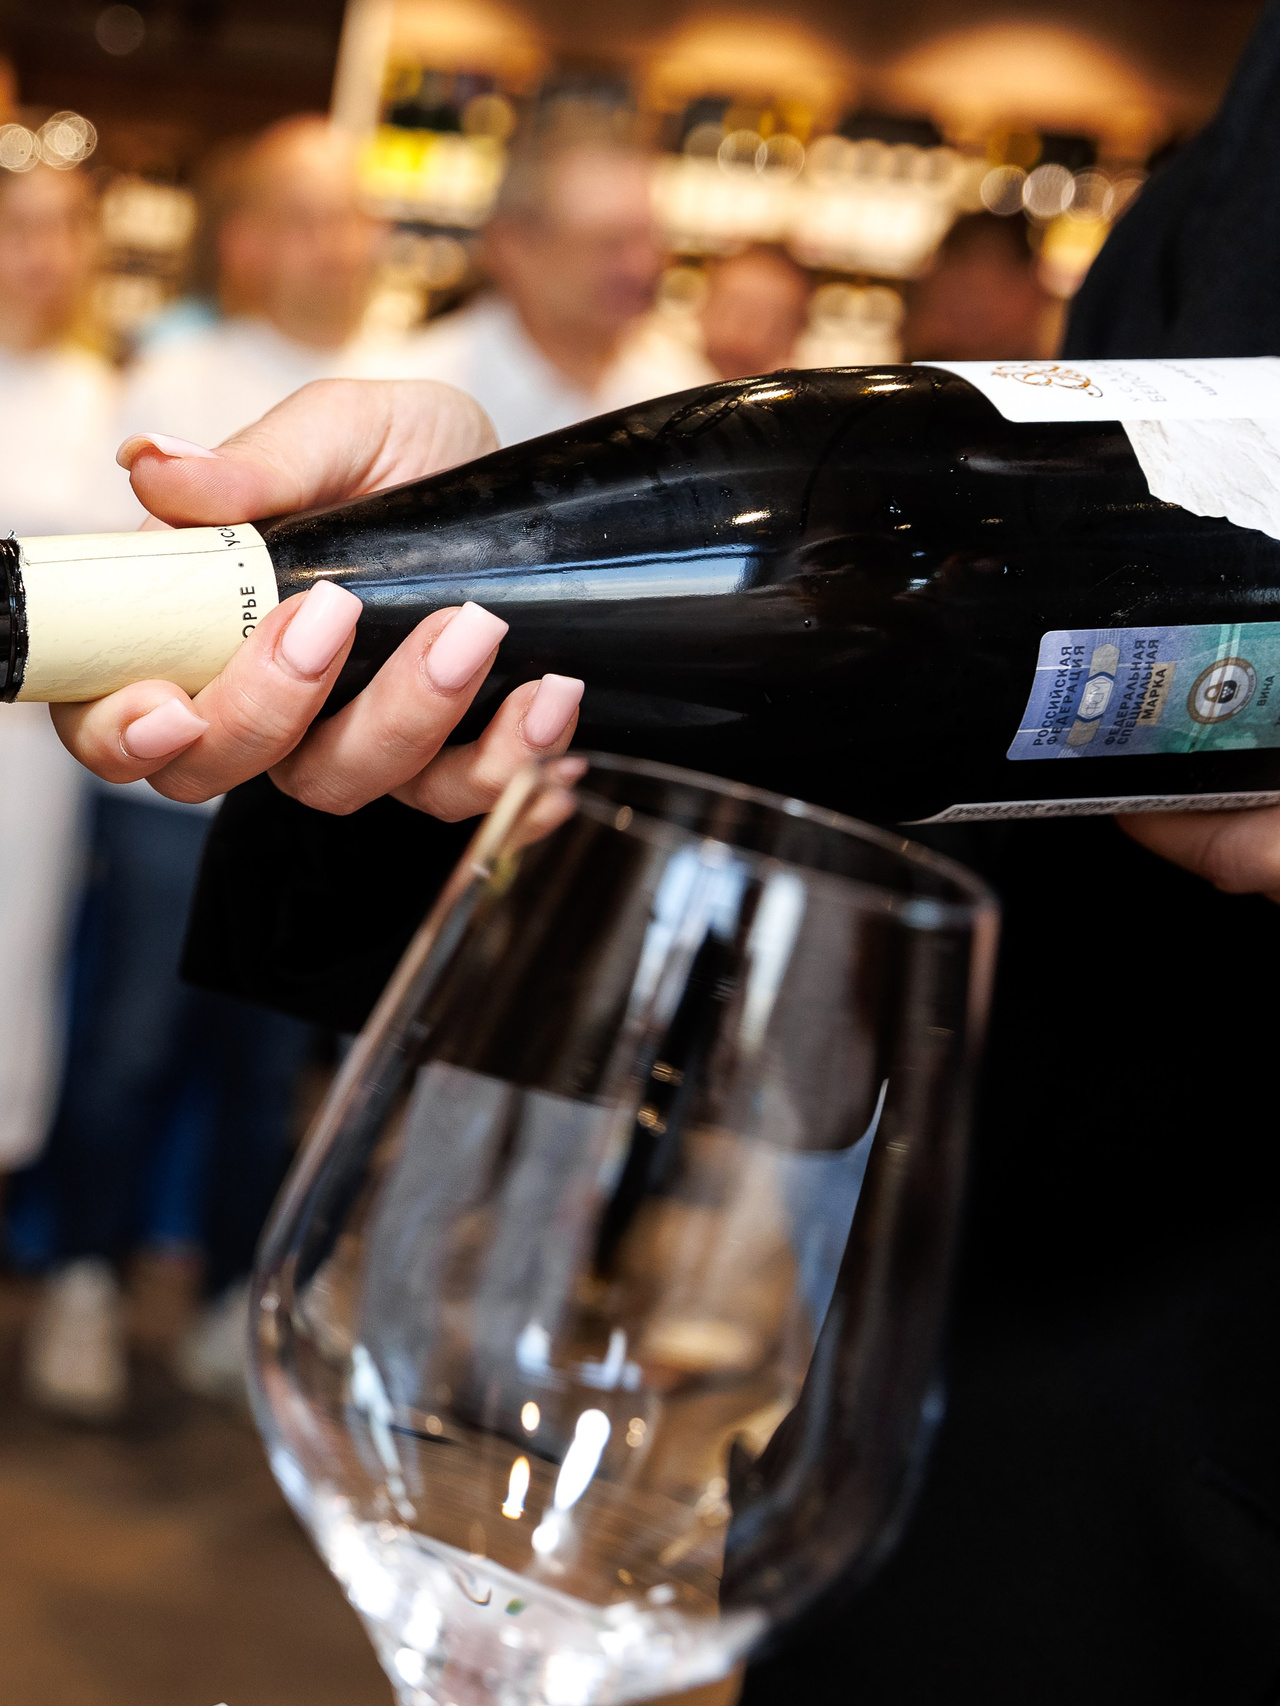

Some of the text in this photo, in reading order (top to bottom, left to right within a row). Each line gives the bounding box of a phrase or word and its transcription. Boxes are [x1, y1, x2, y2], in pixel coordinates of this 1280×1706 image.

[240, 586, 258, 639] ОРЬЕ
[1033, 646, 1073, 746] РОССИЙСКАЯ
[1046, 645, 1085, 745] ФЕДЕРАЦИЯ
[1104, 639, 1147, 745] ФЕДЕРАЛЬНАЯ
[1116, 638, 1160, 745] СПЕЦИАЛЬНАЯ
[1142, 668, 1168, 720] МАРКА
[1256, 675, 1275, 707] ВИНА
